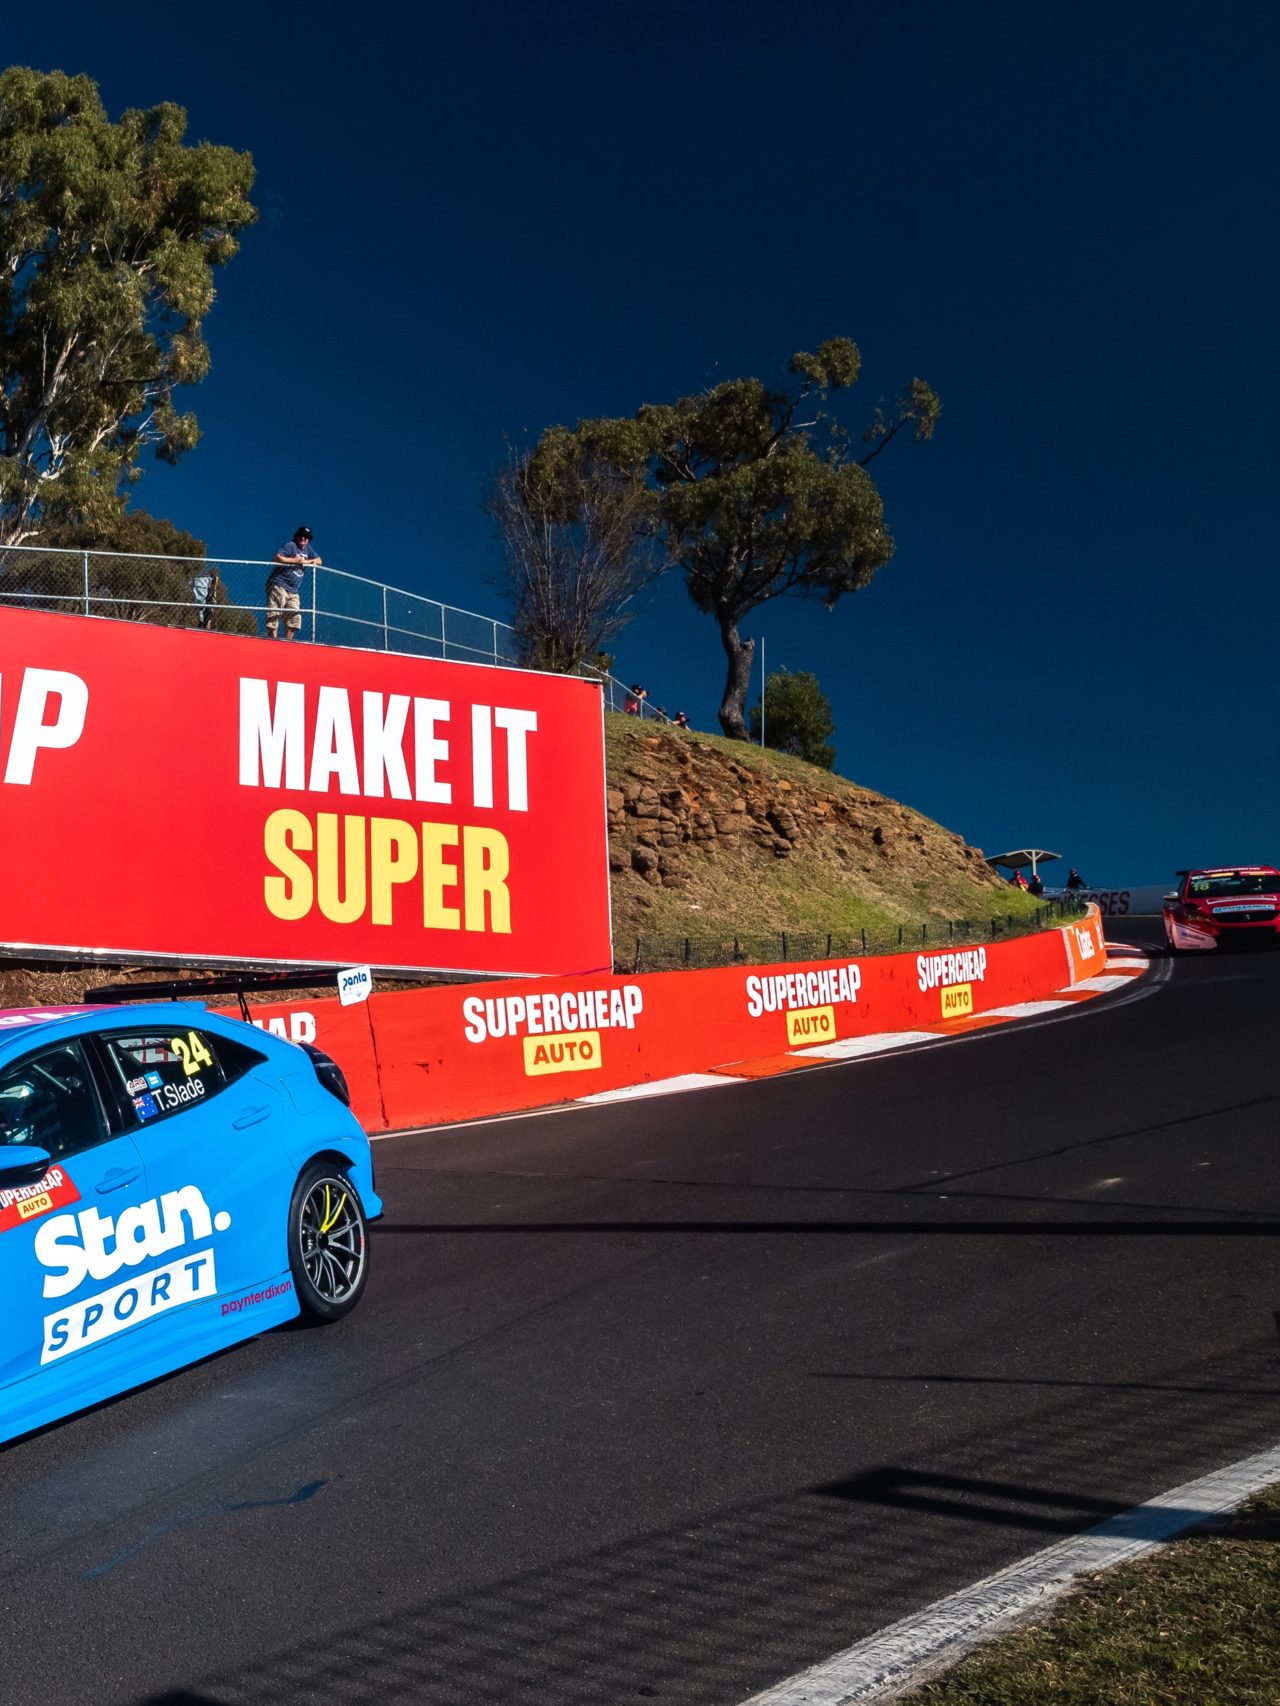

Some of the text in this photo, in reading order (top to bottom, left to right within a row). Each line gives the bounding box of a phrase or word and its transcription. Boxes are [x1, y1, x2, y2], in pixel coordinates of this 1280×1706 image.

[238, 677, 538, 812] MAKE IT
[264, 808, 511, 934] SUPER
[746, 965, 862, 1018] SUPERCHEAP
[917, 947, 987, 993] SUPERCHEAP
[463, 985, 643, 1044] SUPERCHEAP
[945, 991, 970, 1010] AUTO
[793, 1014, 831, 1036] AUTO
[171, 1031, 213, 1076] 24
[534, 1040, 594, 1065] AUTO
[23, 1197, 48, 1214] AUTO
[35, 1184, 232, 1299] Stan.
[48, 1258, 208, 1352] SPORT
[221, 1280, 292, 1317] paynterdixon
